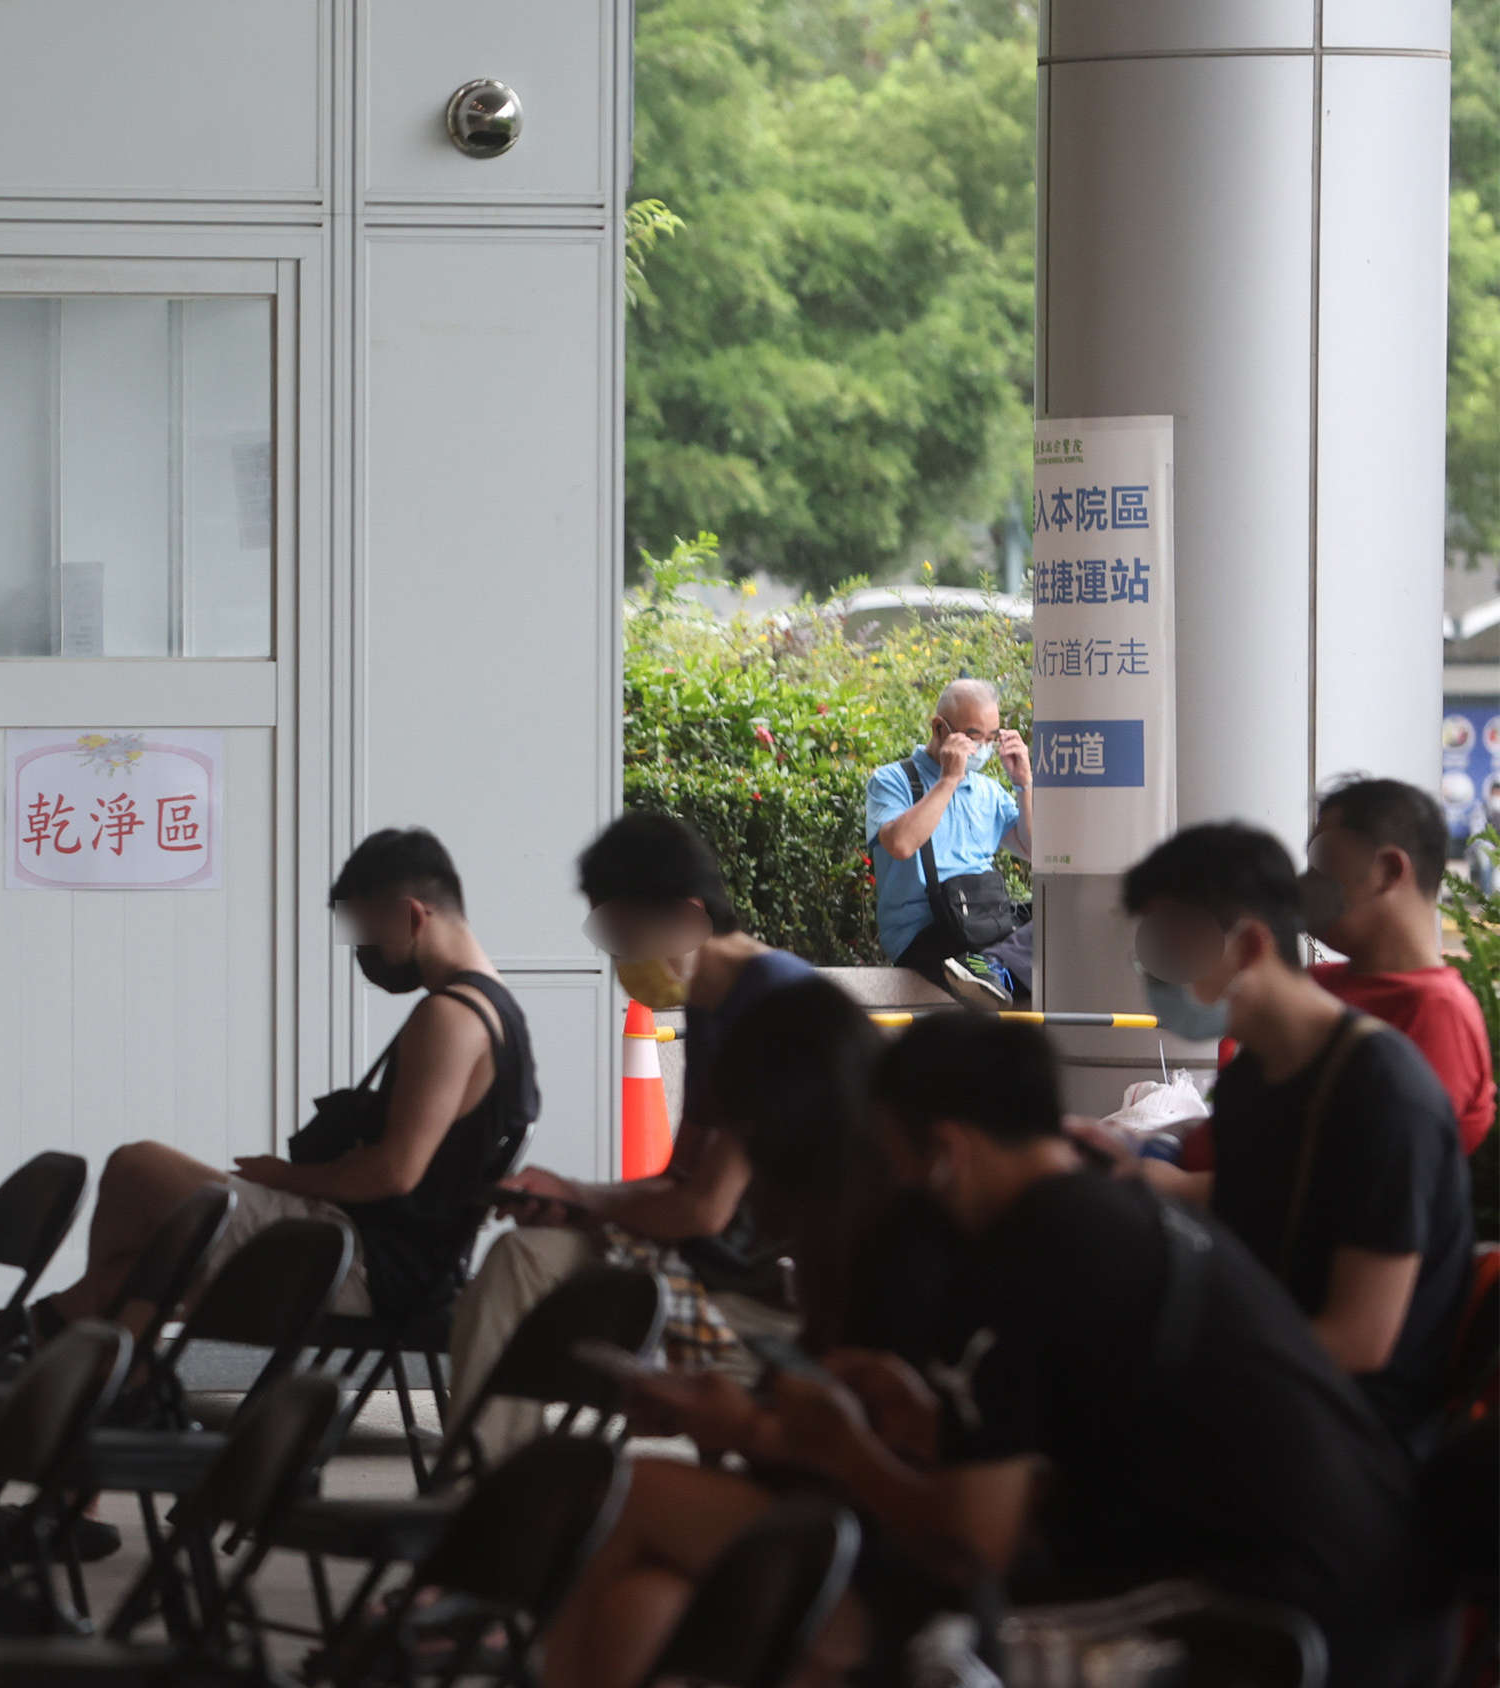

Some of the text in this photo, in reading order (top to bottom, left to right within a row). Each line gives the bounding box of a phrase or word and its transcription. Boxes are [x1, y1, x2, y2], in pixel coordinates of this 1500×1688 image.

[1033, 485, 1150, 532] 入本院區
[1035, 732, 1106, 776] 人行道
[21, 792, 205, 857] 乾淨區
